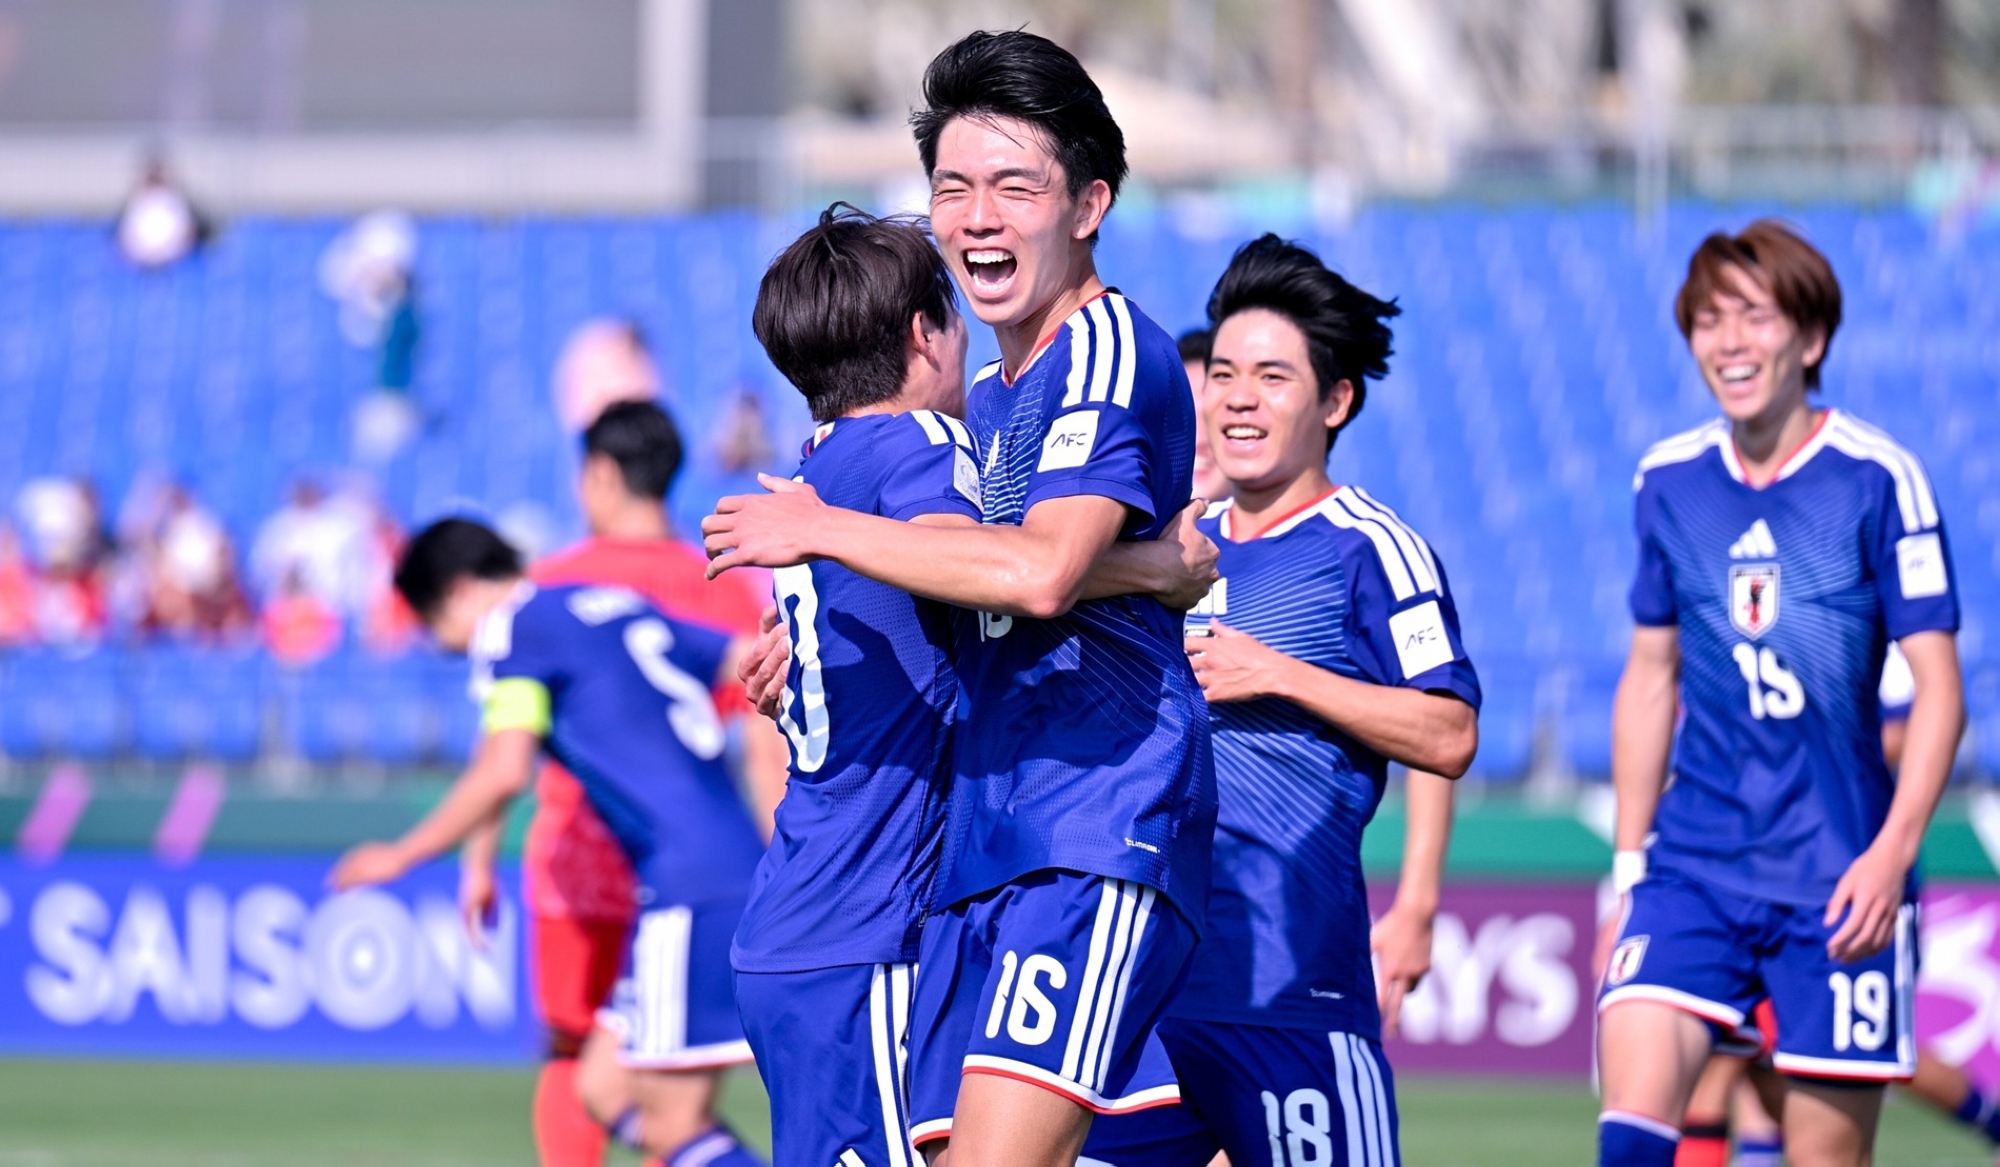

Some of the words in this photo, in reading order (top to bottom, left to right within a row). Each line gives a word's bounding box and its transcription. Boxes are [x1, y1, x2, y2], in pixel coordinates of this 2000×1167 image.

[1050, 433, 1088, 449] AFC
[1405, 626, 1437, 651] AFC
[622, 616, 726, 761] 5
[24, 880, 517, 1029] SAISON
[985, 950, 1068, 1047] 16
[1829, 971, 1890, 1052] 19
[1261, 1088, 1333, 1167] 18
